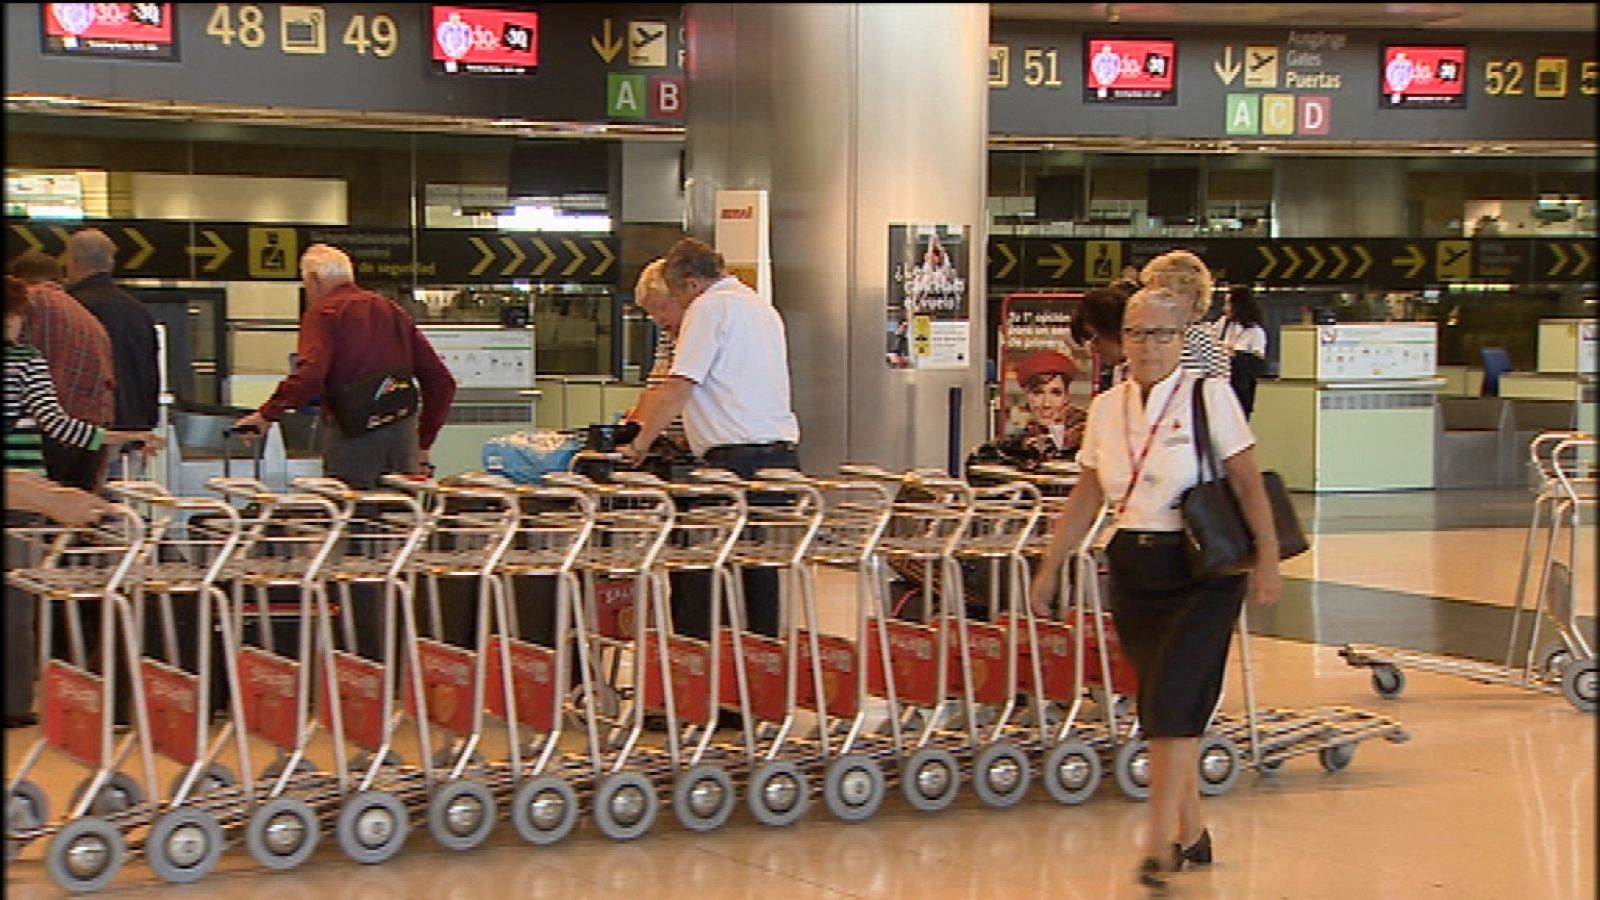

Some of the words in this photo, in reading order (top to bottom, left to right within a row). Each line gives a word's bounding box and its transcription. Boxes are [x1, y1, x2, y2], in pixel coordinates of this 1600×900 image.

[206, 4, 266, 48] 48
[342, 14, 399, 57] 49
[1023, 50, 1063, 87] 51
[1285, 71, 1342, 89] Puertas
[1484, 61, 1525, 96] 52
[615, 80, 638, 111] A
[659, 80, 680, 111] B
[1232, 99, 1252, 127] A
[1270, 99, 1289, 129] C
[1303, 101, 1324, 129] D
